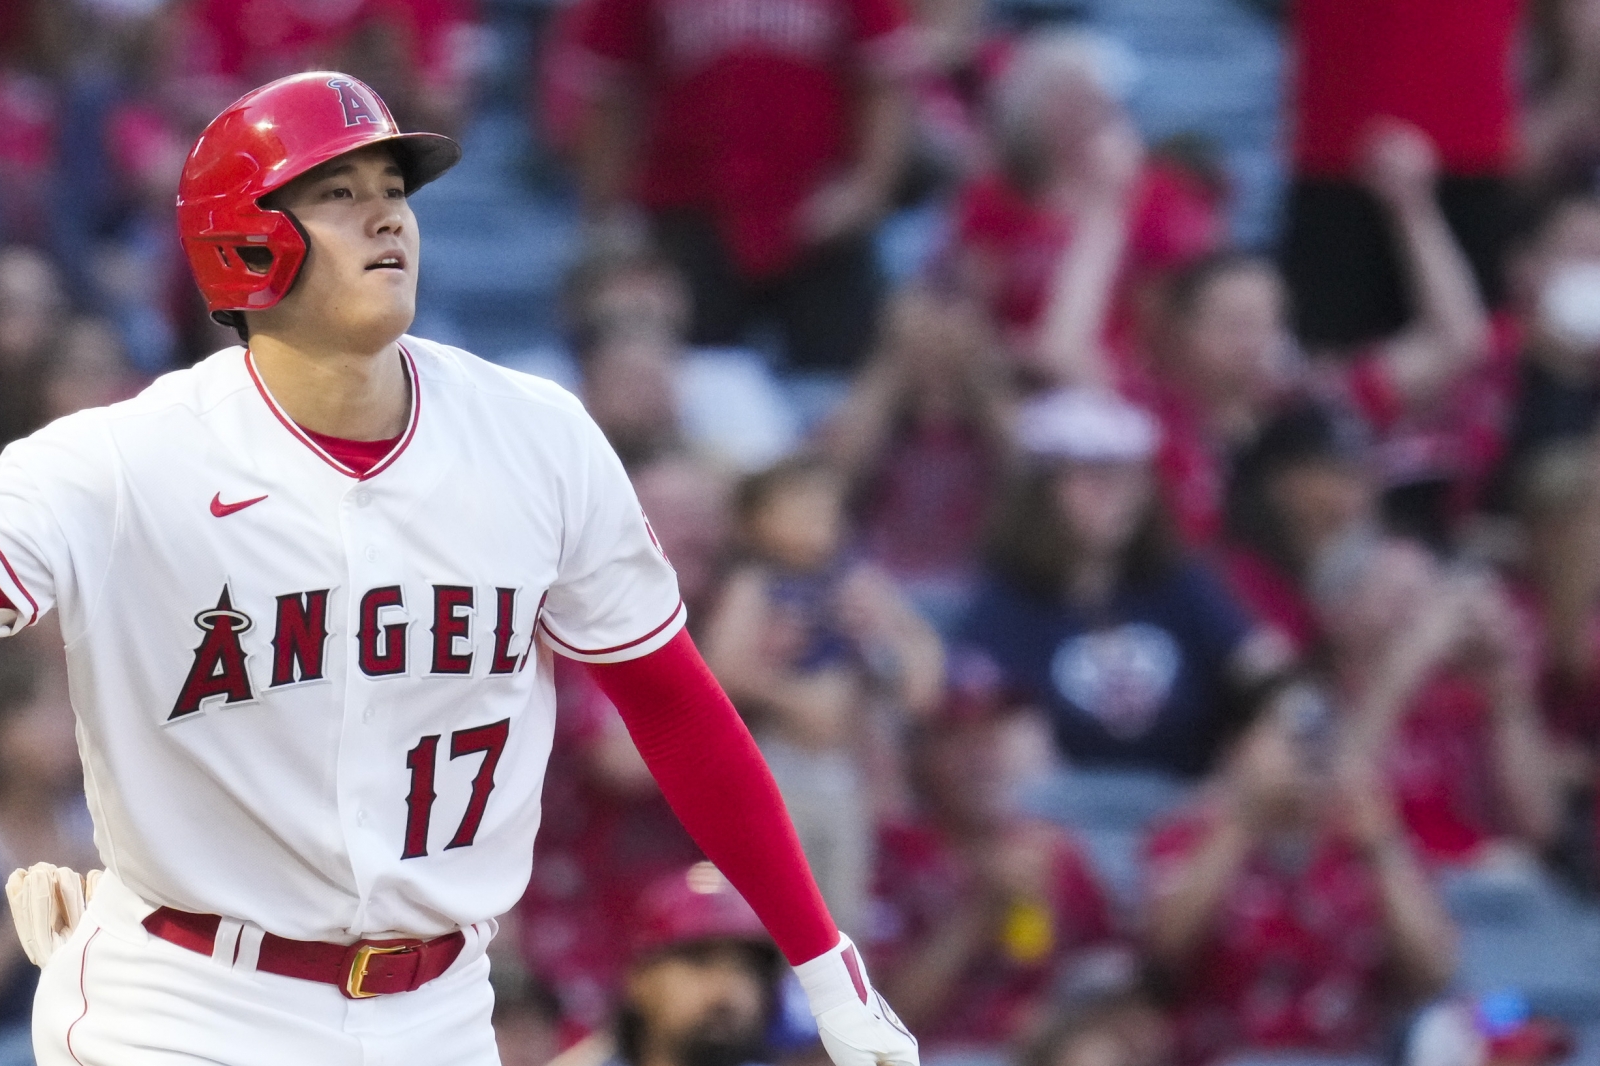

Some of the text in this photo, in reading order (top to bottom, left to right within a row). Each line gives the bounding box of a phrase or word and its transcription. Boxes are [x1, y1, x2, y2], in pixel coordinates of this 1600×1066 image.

[327, 77, 379, 128] A
[162, 577, 549, 725] ANGEL
[400, 716, 511, 861] 17
